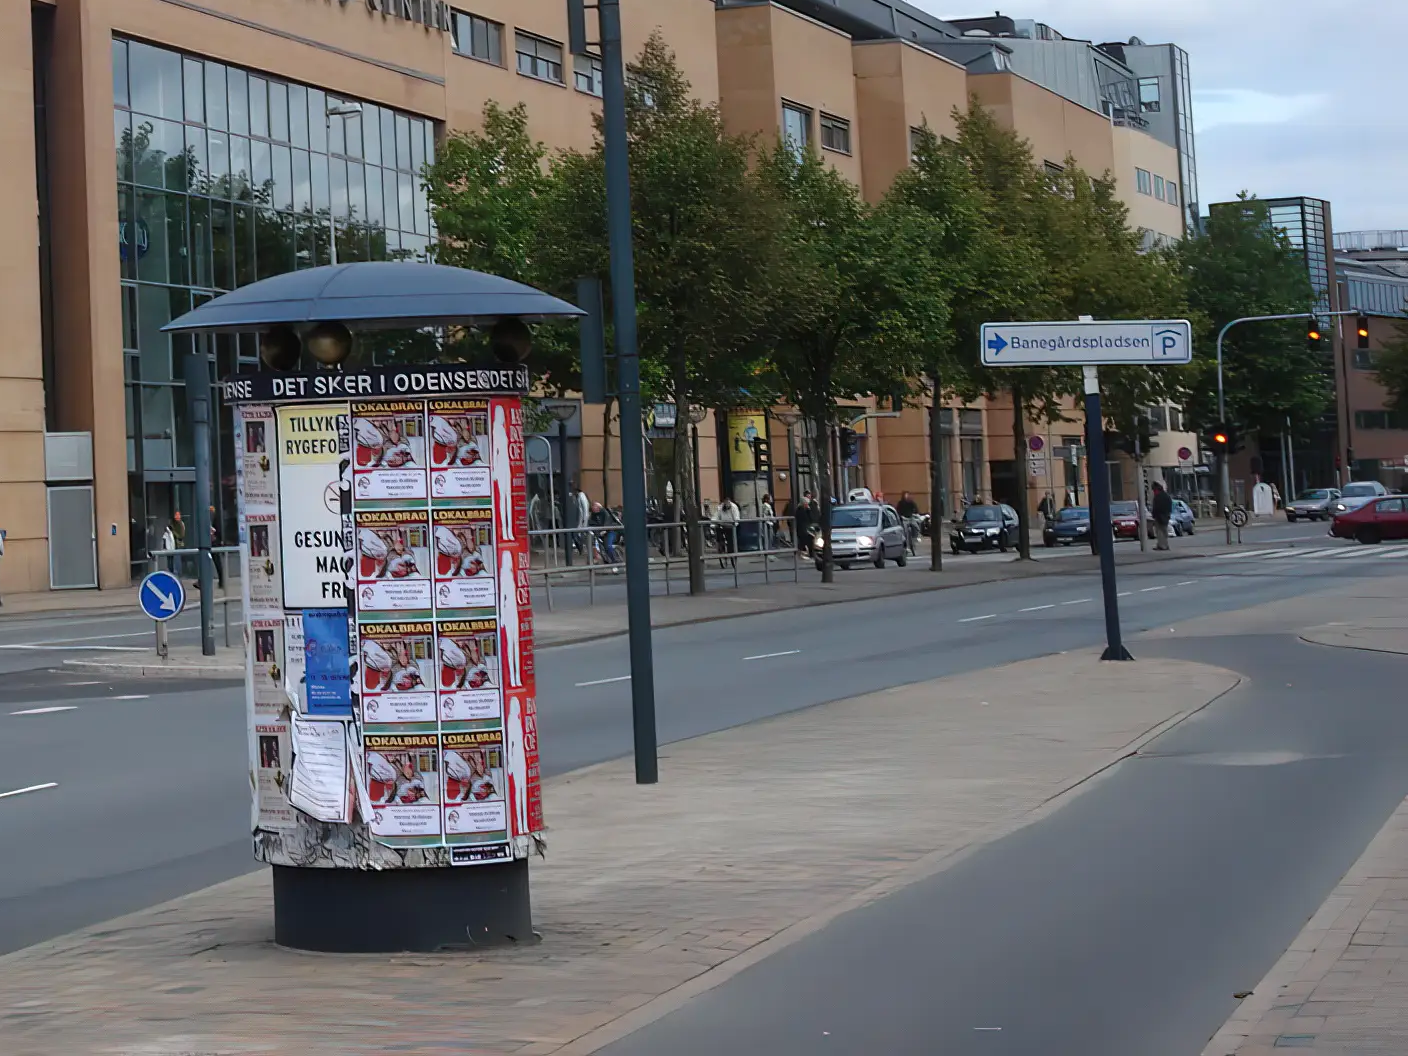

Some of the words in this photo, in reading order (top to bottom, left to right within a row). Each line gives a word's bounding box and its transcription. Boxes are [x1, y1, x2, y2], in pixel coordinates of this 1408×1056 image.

[1010, 335, 1150, 352] Banegårdspladsen
[273, 376, 308, 397] DET
[314, 374, 371, 395] SKER
[380, 374, 385, 392] I
[394, 371, 477, 392] ODENSE
[490, 370, 513, 388] DET
